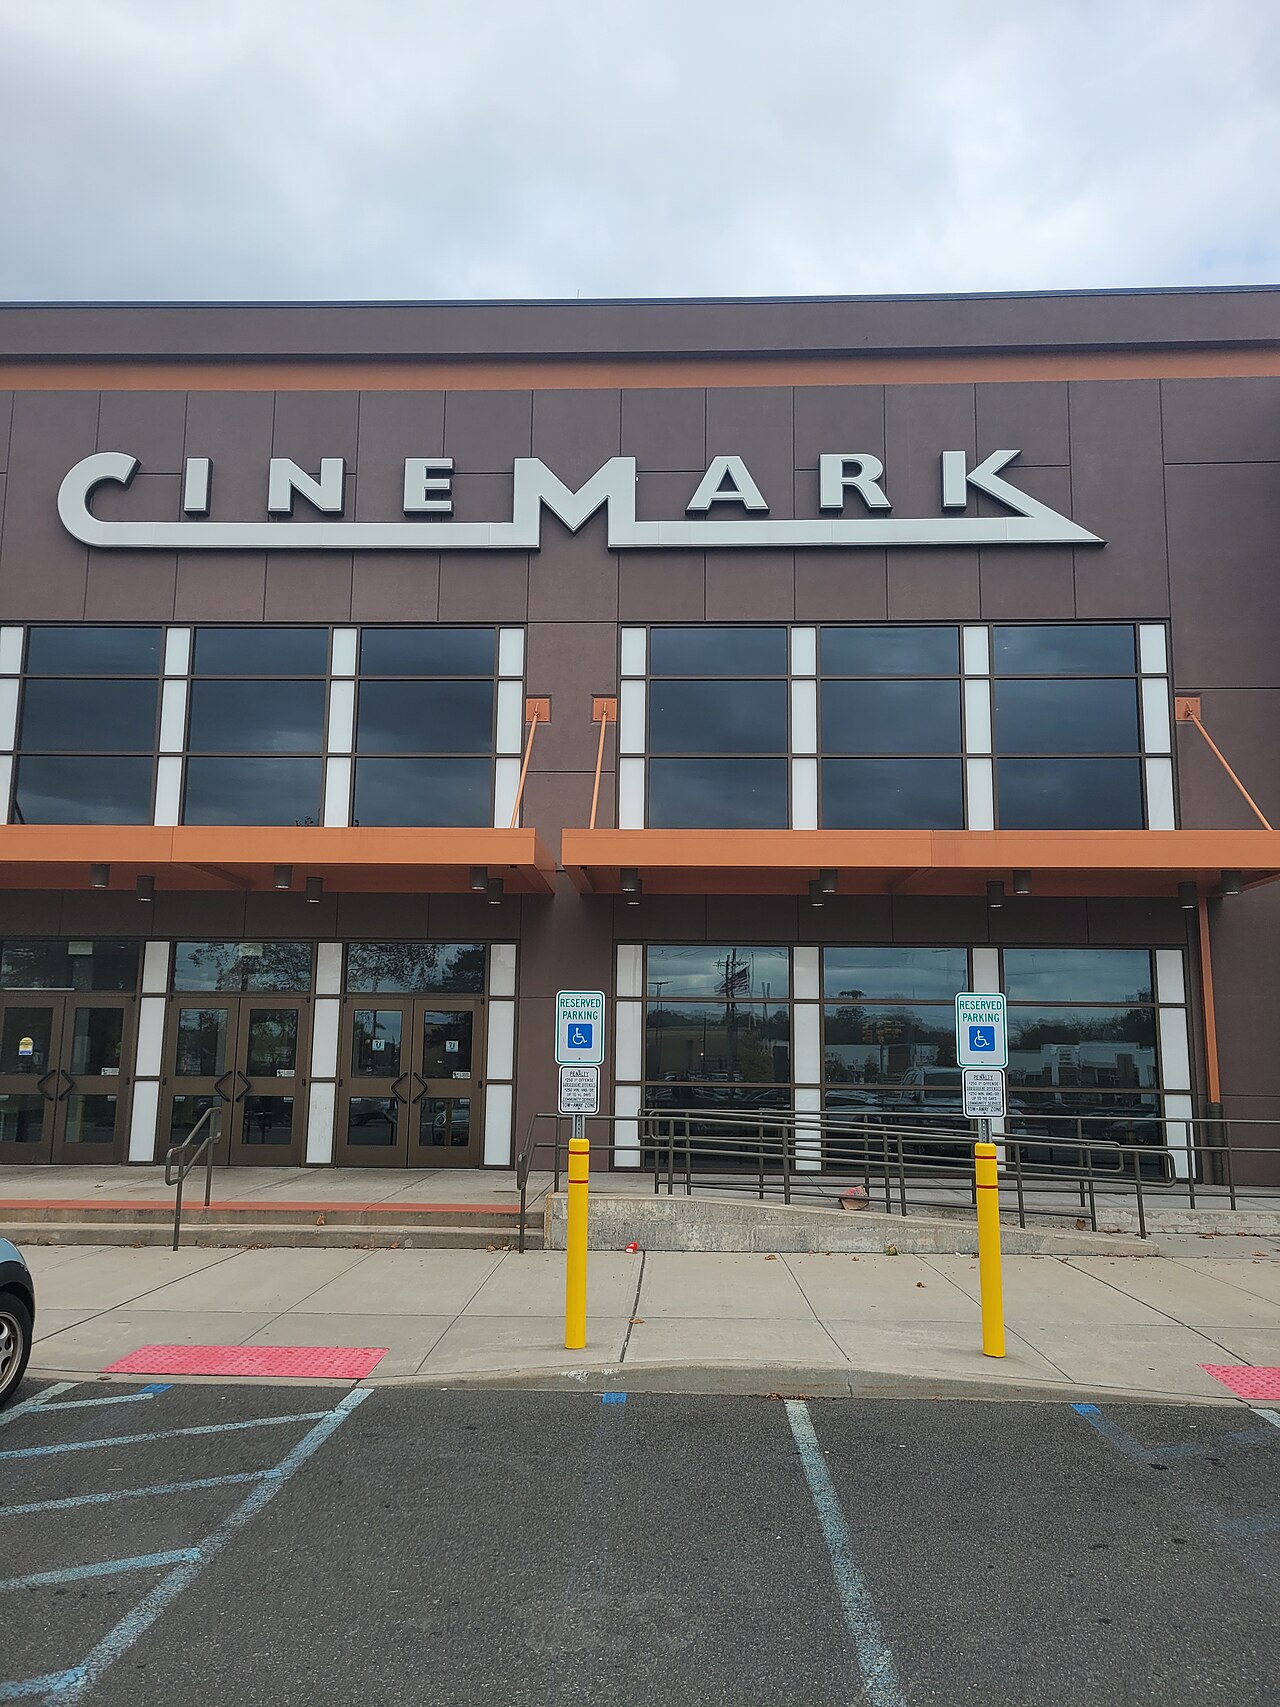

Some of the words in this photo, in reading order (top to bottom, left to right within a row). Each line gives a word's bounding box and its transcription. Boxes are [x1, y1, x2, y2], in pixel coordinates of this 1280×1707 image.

[57, 449, 1105, 548] CINEMARK
[560, 998, 601, 1008] RESERVED
[960, 1000, 1002, 1010] RESERVED
[562, 1011, 598, 1020] PARKING
[962, 1013, 1000, 1022] PARKING
